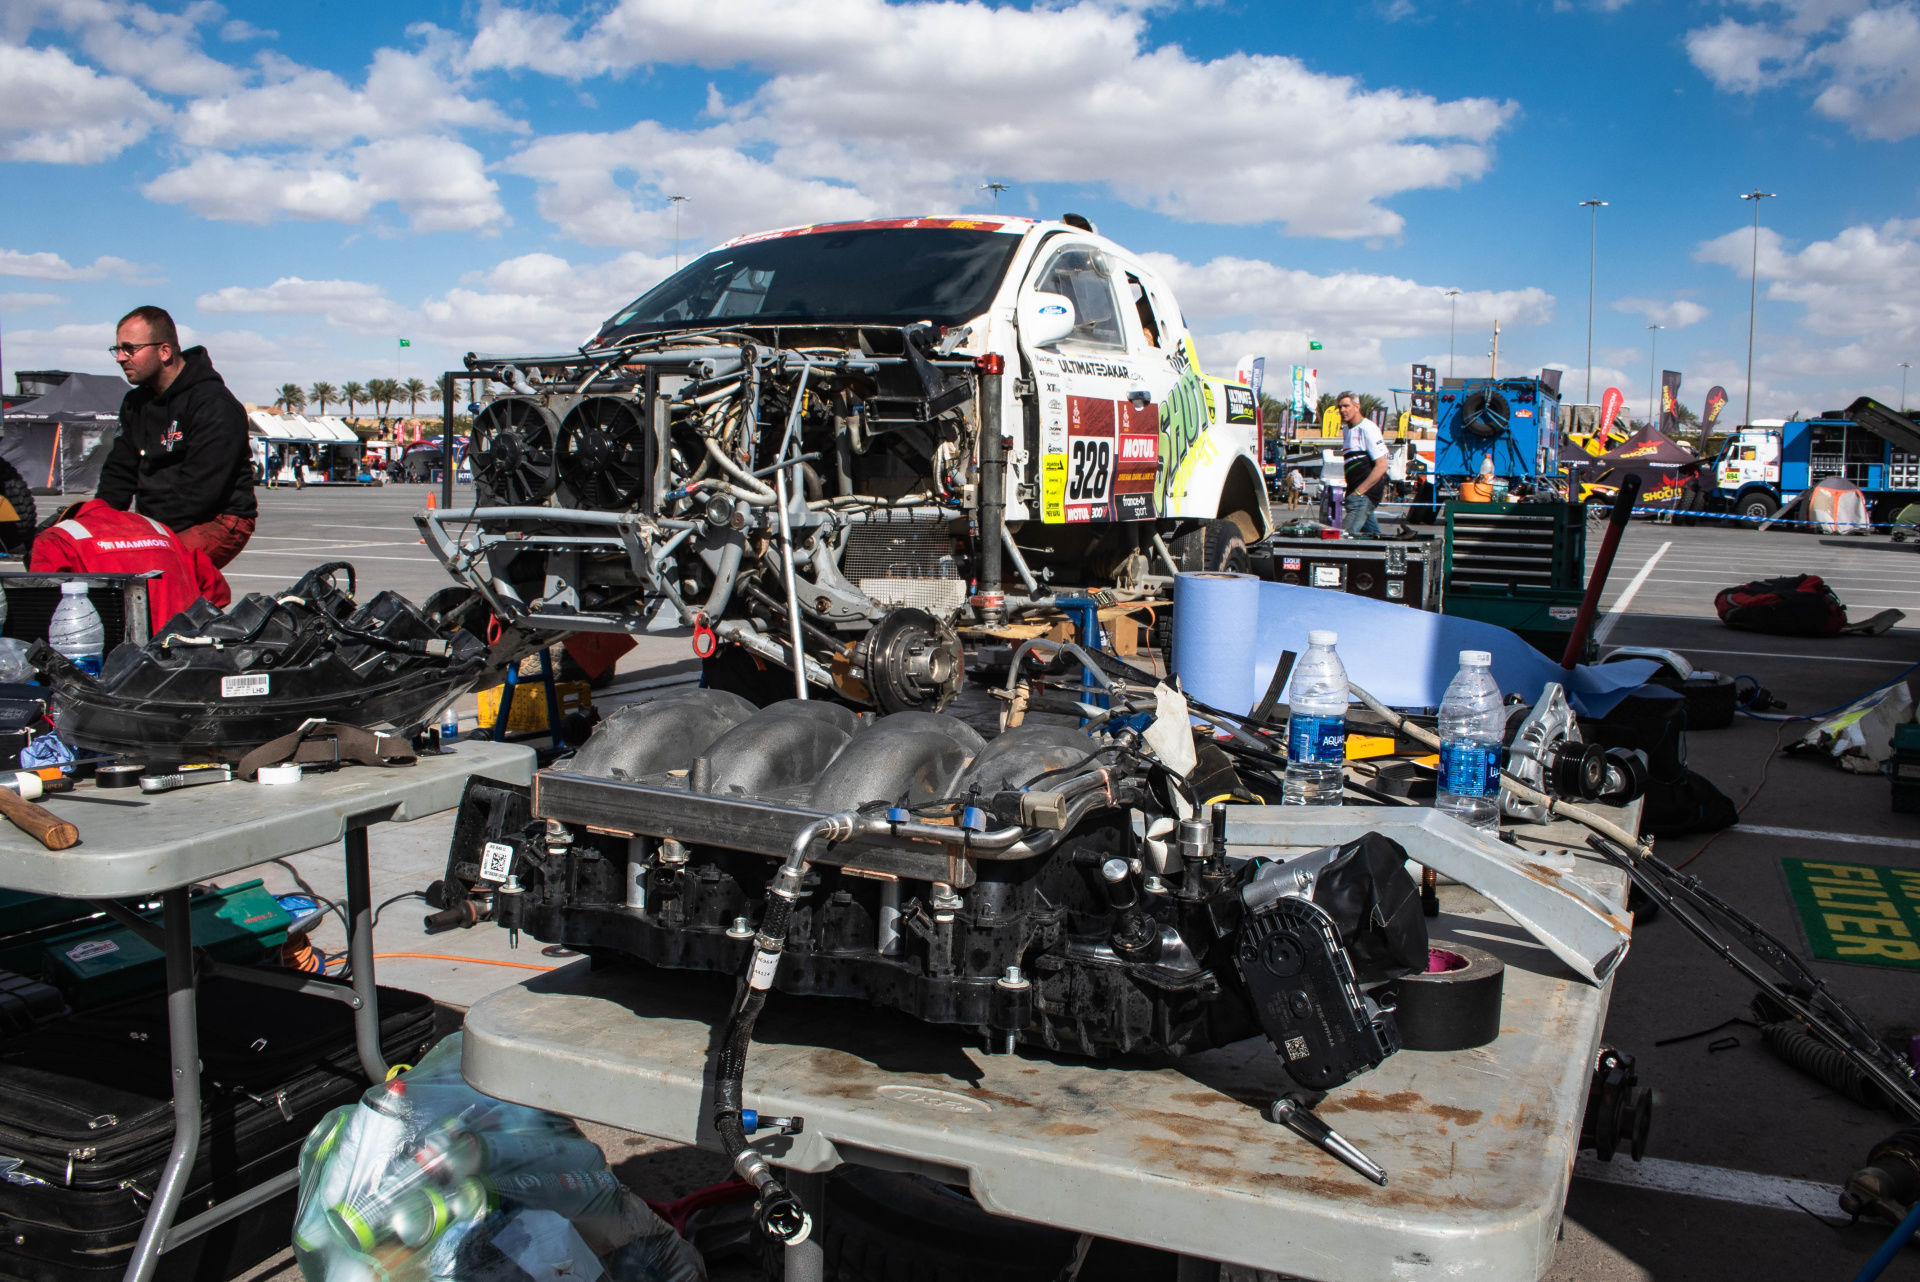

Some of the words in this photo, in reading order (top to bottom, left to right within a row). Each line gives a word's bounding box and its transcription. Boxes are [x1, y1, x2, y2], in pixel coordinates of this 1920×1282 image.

[1123, 438, 1155, 459] MOTUL
[1069, 440, 1110, 500] 328
[1067, 507, 1090, 519] MOTUL
[1090, 506, 1108, 518] 300V
[1801, 862, 1920, 961] FILTER
